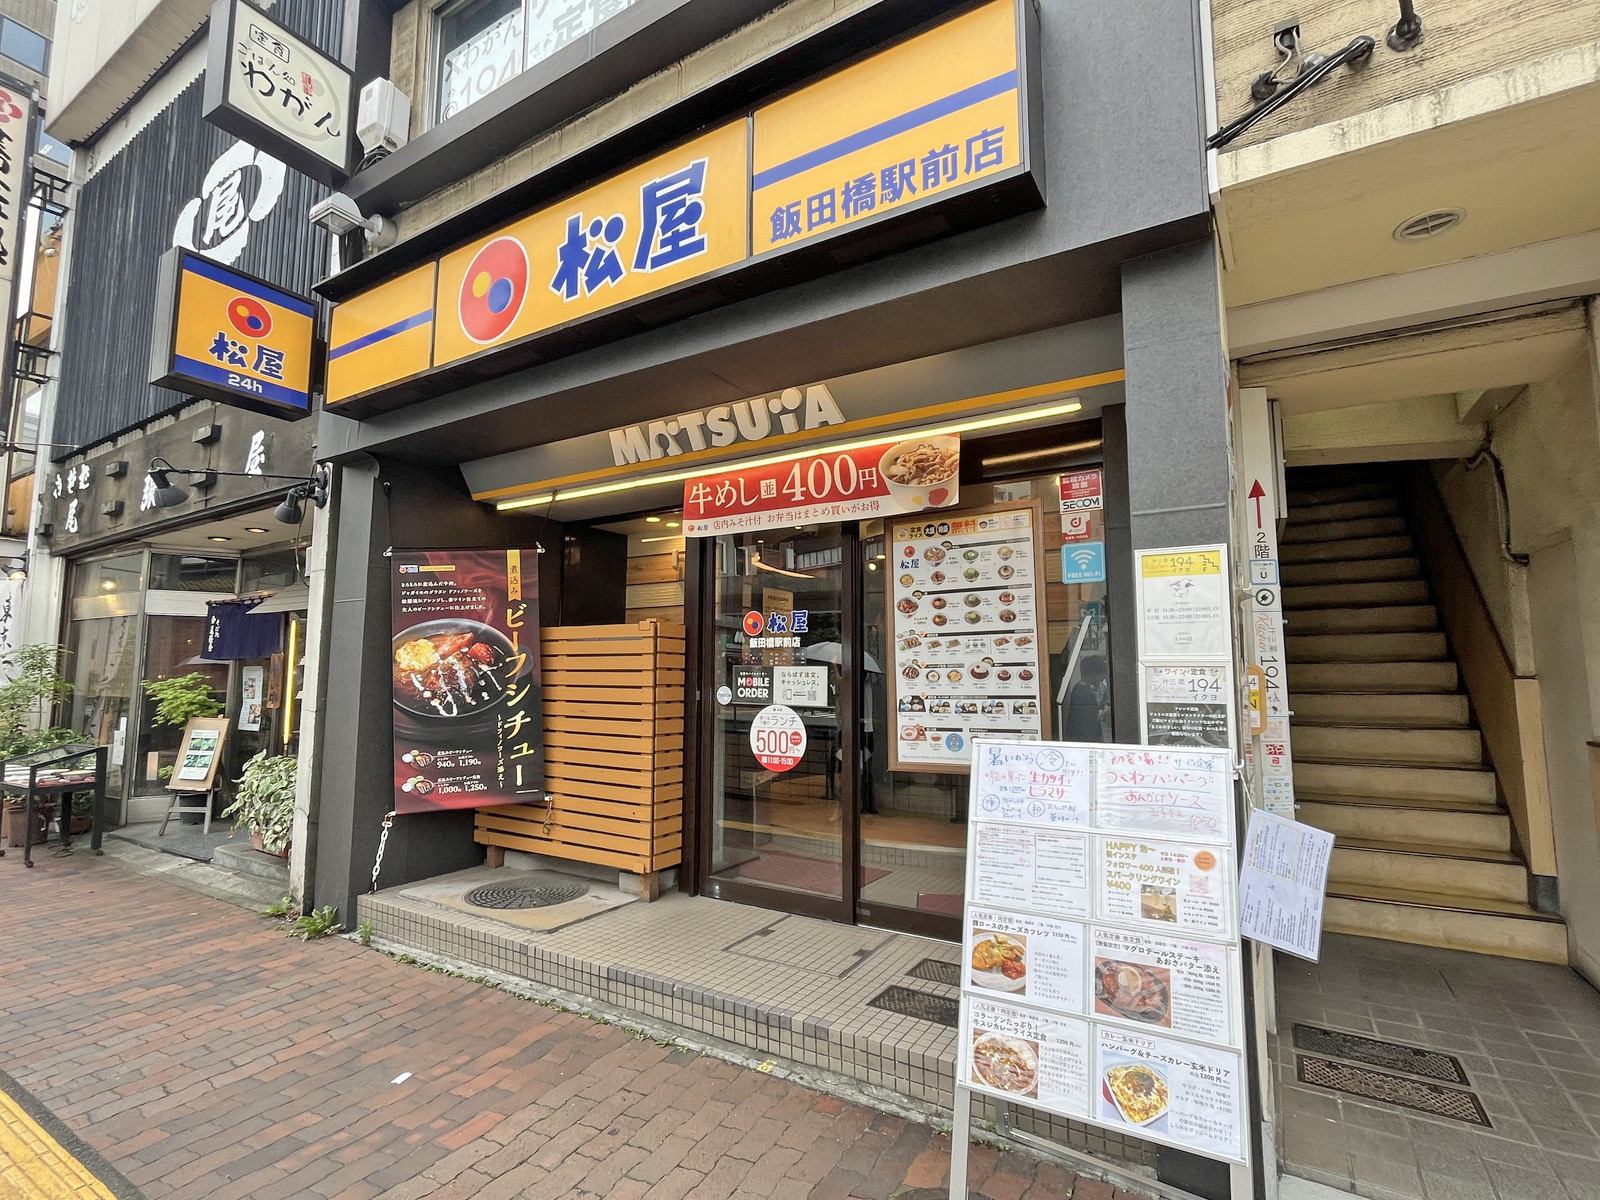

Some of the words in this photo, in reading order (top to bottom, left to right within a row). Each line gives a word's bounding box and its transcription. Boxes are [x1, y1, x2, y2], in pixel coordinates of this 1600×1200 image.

[255, 30, 284, 58] 定食
[240, 61, 340, 137] わがん
[769, 125, 1007, 245] 飯田橋駅前店
[548, 156, 710, 304] 松屋
[208, 331, 285, 381] 松屋
[227, 373, 263, 394] 24h
[608, 384, 847, 467] MATSUYA
[688, 476, 759, 515] 牛めし
[781, 453, 878, 501] 400円
[1063, 497, 1100, 510] SECOM
[713, 515, 762, 531] 店内みそ汁付
[767, 500, 881, 523] お弁当はまとめ買いがお得
[900, 559, 920, 569] 松屋
[1170, 557, 1194, 567] 194
[509, 565, 519, 595] 煮込み
[767, 609, 809, 633] 松屋
[749, 636, 801, 649] 飯田橋駅前店
[737, 676, 770, 687] MOBILE
[1260, 656, 1280, 693] 194
[737, 687, 769, 698] ORDER
[1188, 678, 1222, 692] 194
[504, 603, 535, 787] ビーフシチュー
[771, 716, 797, 727] ランチ
[988, 747, 1034, 766] 暑いから
[1029, 786, 1066, 799] ヒラマサ
[1106, 841, 1137, 852] HAPPY
[1106, 860, 1138, 869] フォロワー
[1139, 864, 1154, 872] 400
[1106, 871, 1180, 886] スパークリングワイン
[1106, 880, 1131, 890] ¥400
[972, 920, 1050, 937] 豚ロースのチーズカツレツ
[1123, 944, 1200, 963] マグロテールステーキ
[1156, 957, 1220, 975] あおさバター添え
[973, 1019, 1047, 1041] 牛スジカレーライス定食
[974, 1012, 1038, 1031] コラーゲンたっぷり！
[1104, 1032, 1153, 1047] カレー玄米ドリア
